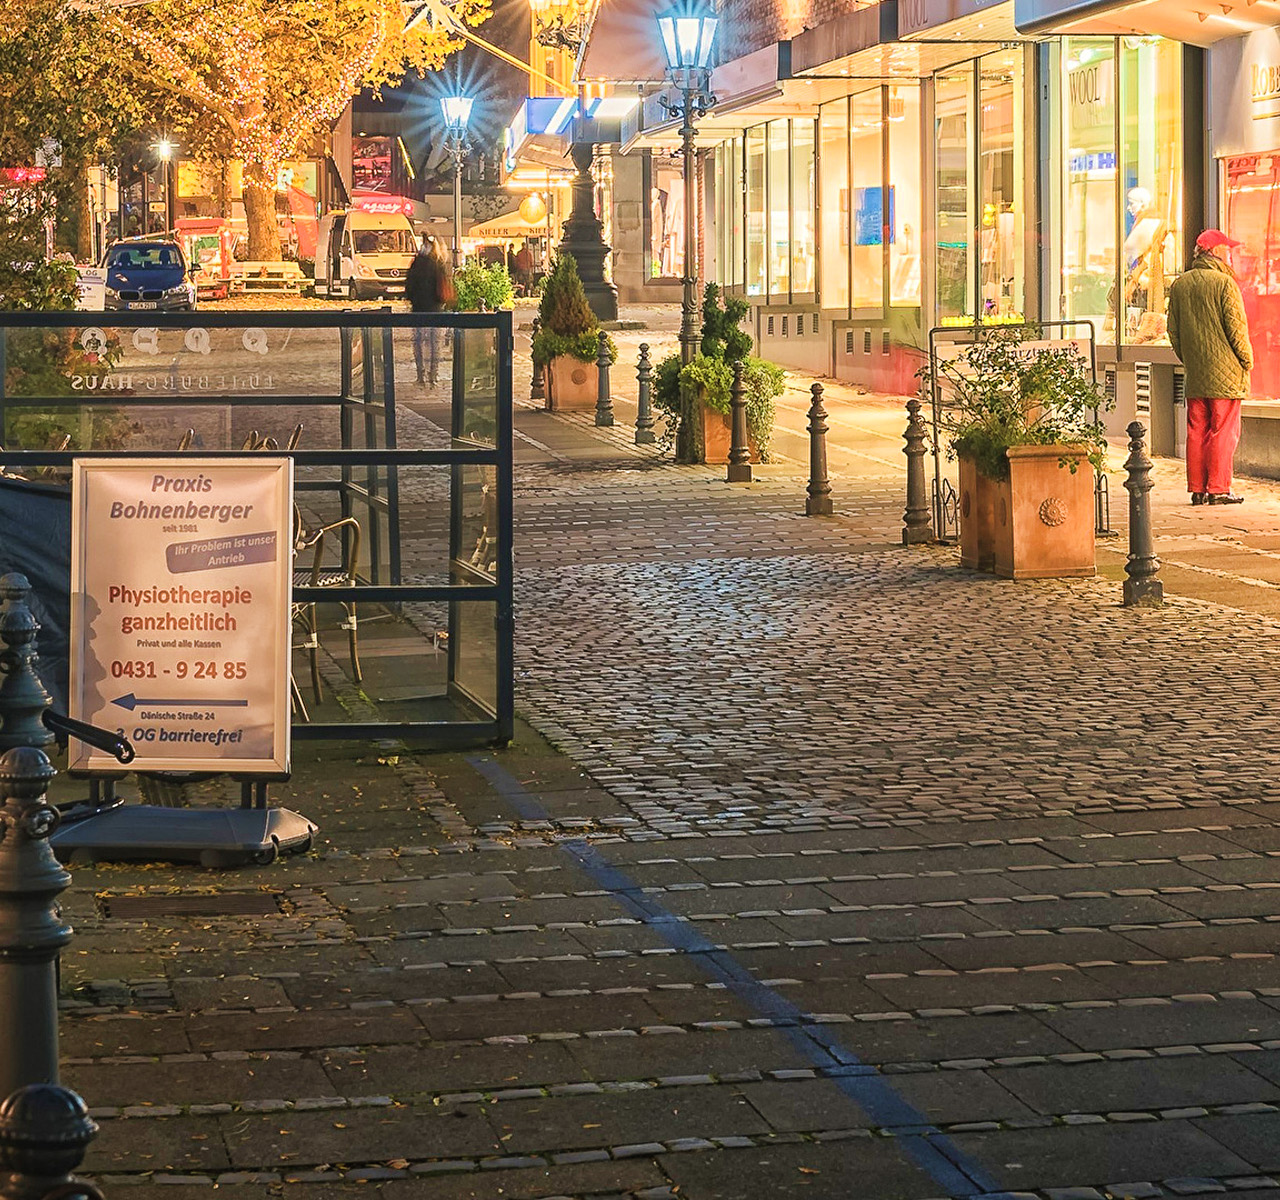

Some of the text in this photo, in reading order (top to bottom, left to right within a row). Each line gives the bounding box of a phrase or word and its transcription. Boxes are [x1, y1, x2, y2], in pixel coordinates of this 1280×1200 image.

[1068, 66, 1100, 105] WOOL
[151, 474, 213, 493] Praxis
[110, 500, 254, 523] Bohnenberger
[162, 524, 178, 533] seit
[174, 534, 276, 556] Ihr Problem ist unser
[207, 554, 245, 567] Antrieb
[108, 585, 253, 608] Physiotherapie
[121, 612, 237, 634] ganzheitlich
[136, 639, 222, 648] Privat und alle Kassen
[111, 660, 157, 679] 0431
[176, 660, 188, 679] 9
[193, 661, 218, 679] 24
[223, 661, 248, 680] 85
[140, 711, 215, 721] Dänische Straße 24
[132, 728, 156, 742] OG
[159, 727, 243, 745] barrierefrei
